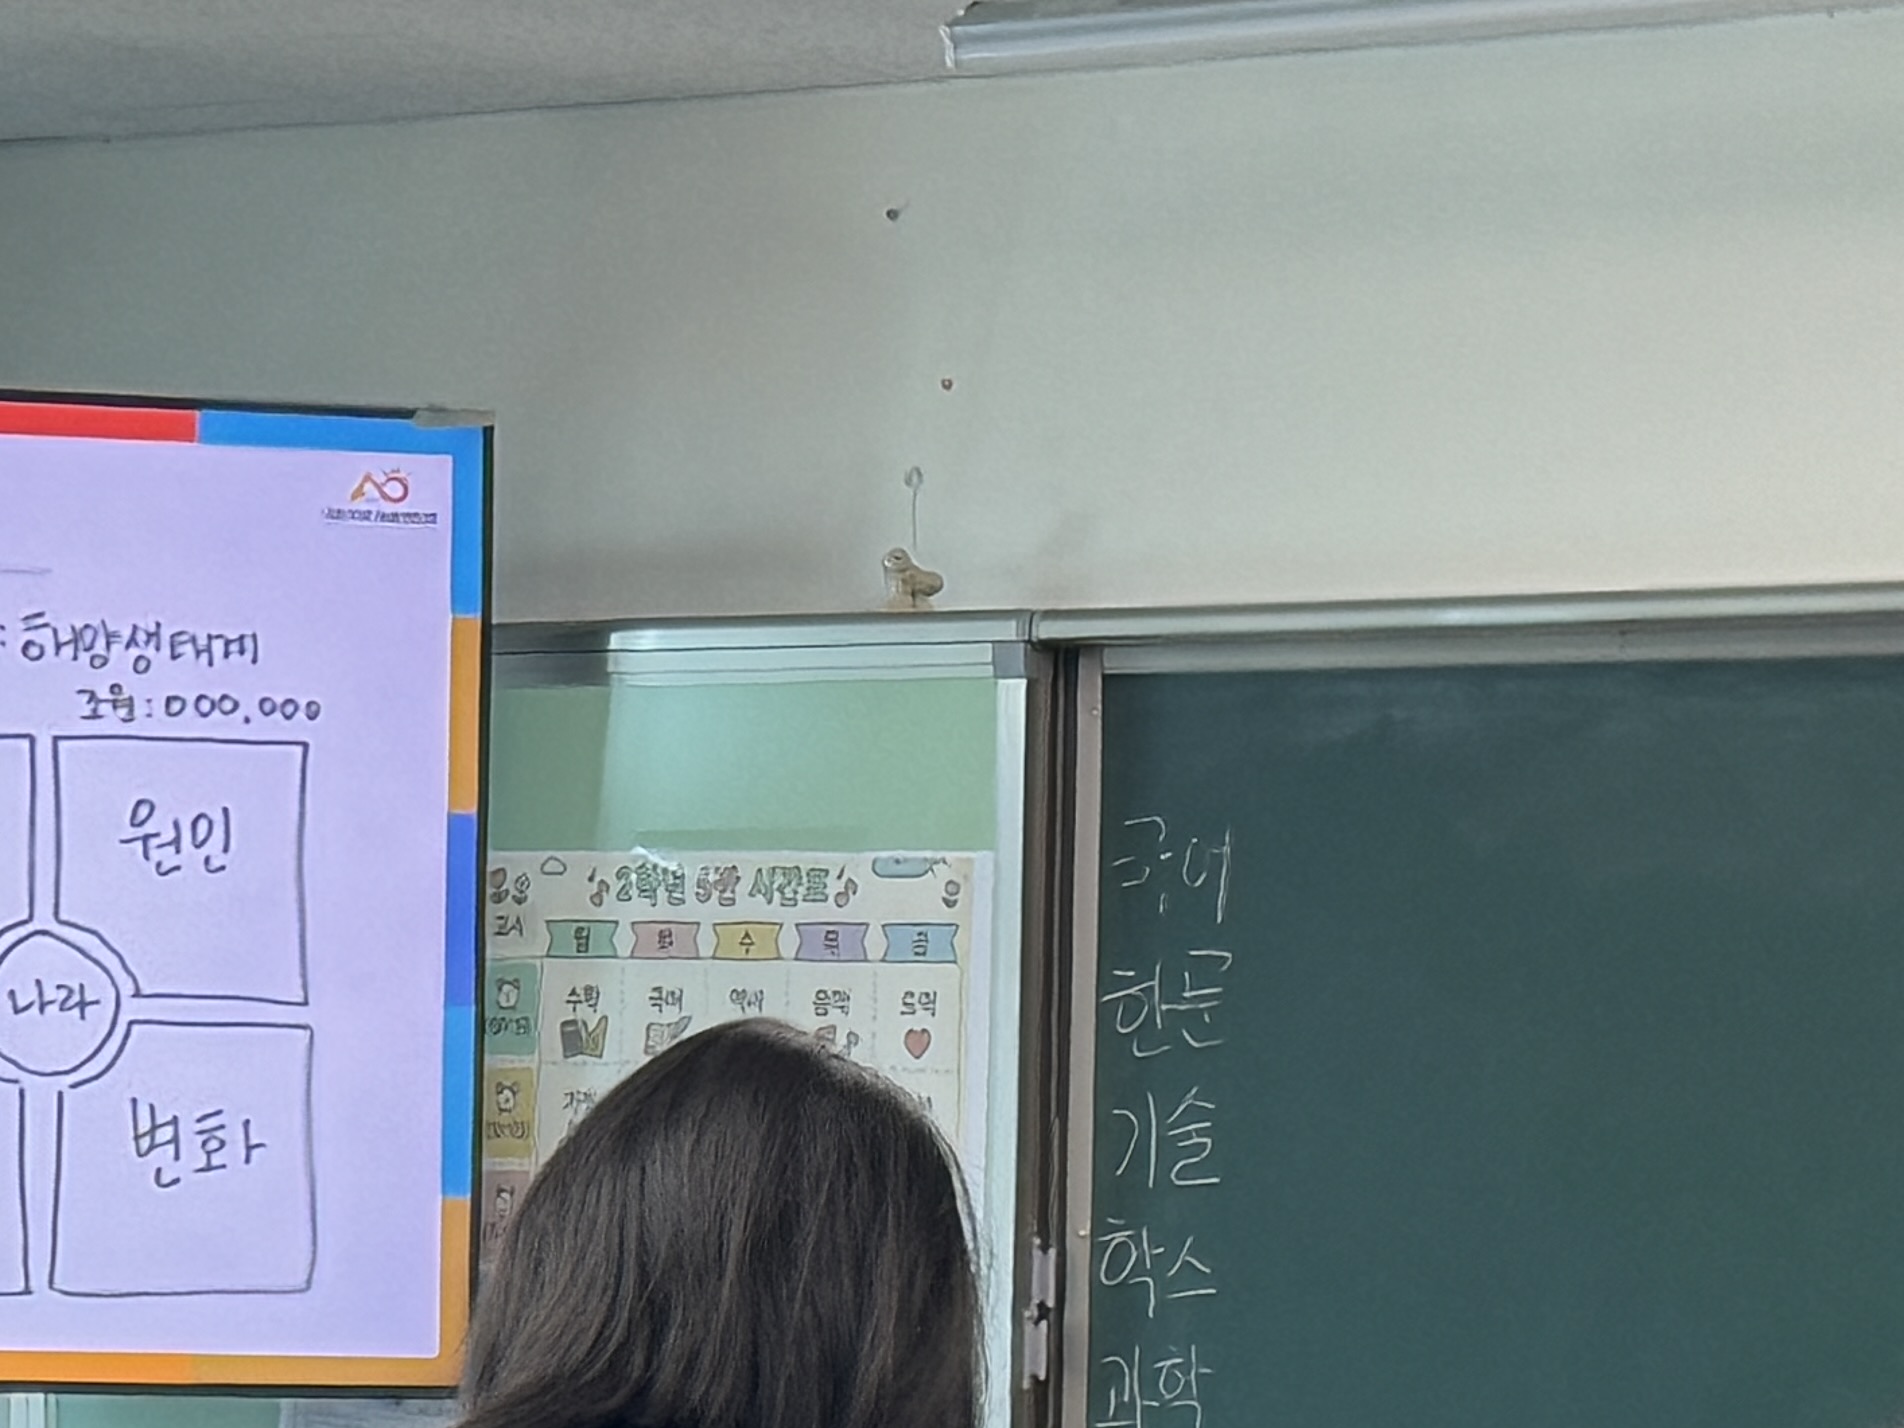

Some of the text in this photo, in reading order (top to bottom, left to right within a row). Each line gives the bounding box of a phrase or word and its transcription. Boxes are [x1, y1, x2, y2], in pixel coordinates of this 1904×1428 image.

[118, 797, 234, 875] 원인
[1111, 816, 1233, 924] 국어
[7, 981, 101, 1021] 나라
[129, 1096, 268, 1188] 변화
[1112, 1086, 1221, 1189] 기술
